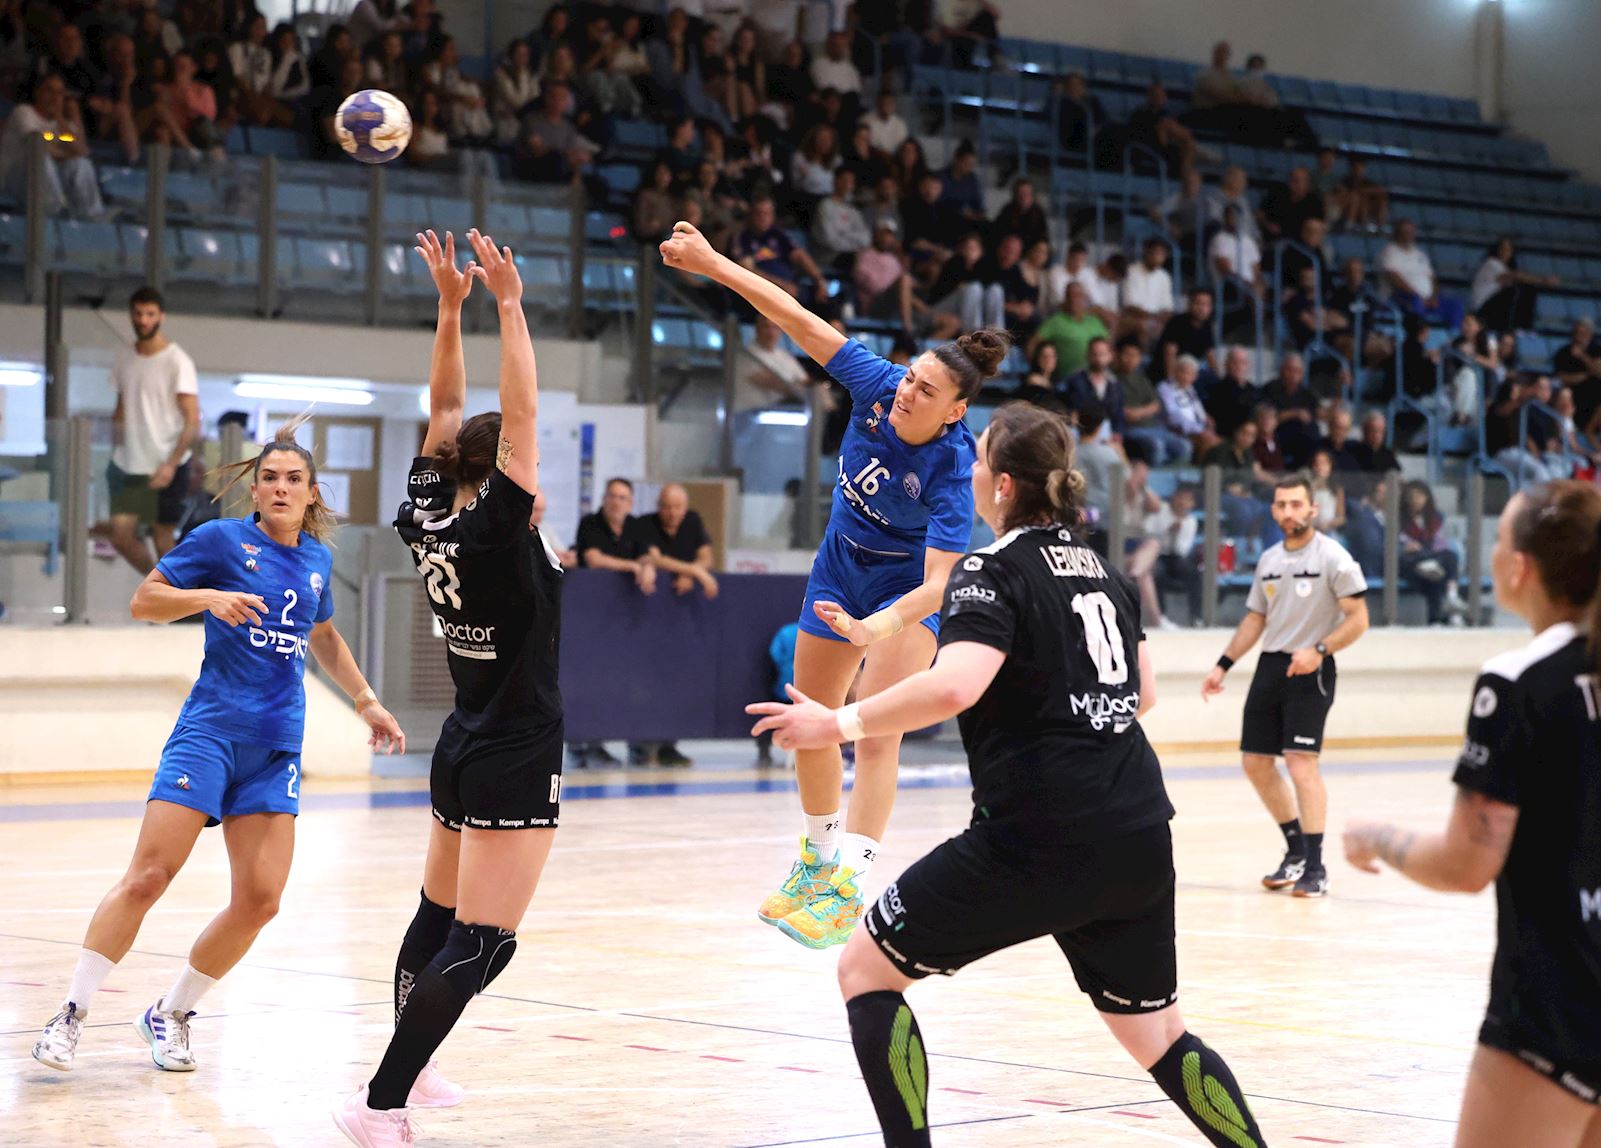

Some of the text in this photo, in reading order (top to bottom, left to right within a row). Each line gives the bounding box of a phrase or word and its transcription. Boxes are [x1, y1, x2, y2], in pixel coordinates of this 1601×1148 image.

[853, 457, 891, 496] 16
[281, 589, 298, 627] 2
[1071, 591, 1128, 685] 10
[287, 763, 298, 799] 2
[499, 819, 524, 828] Kempa
